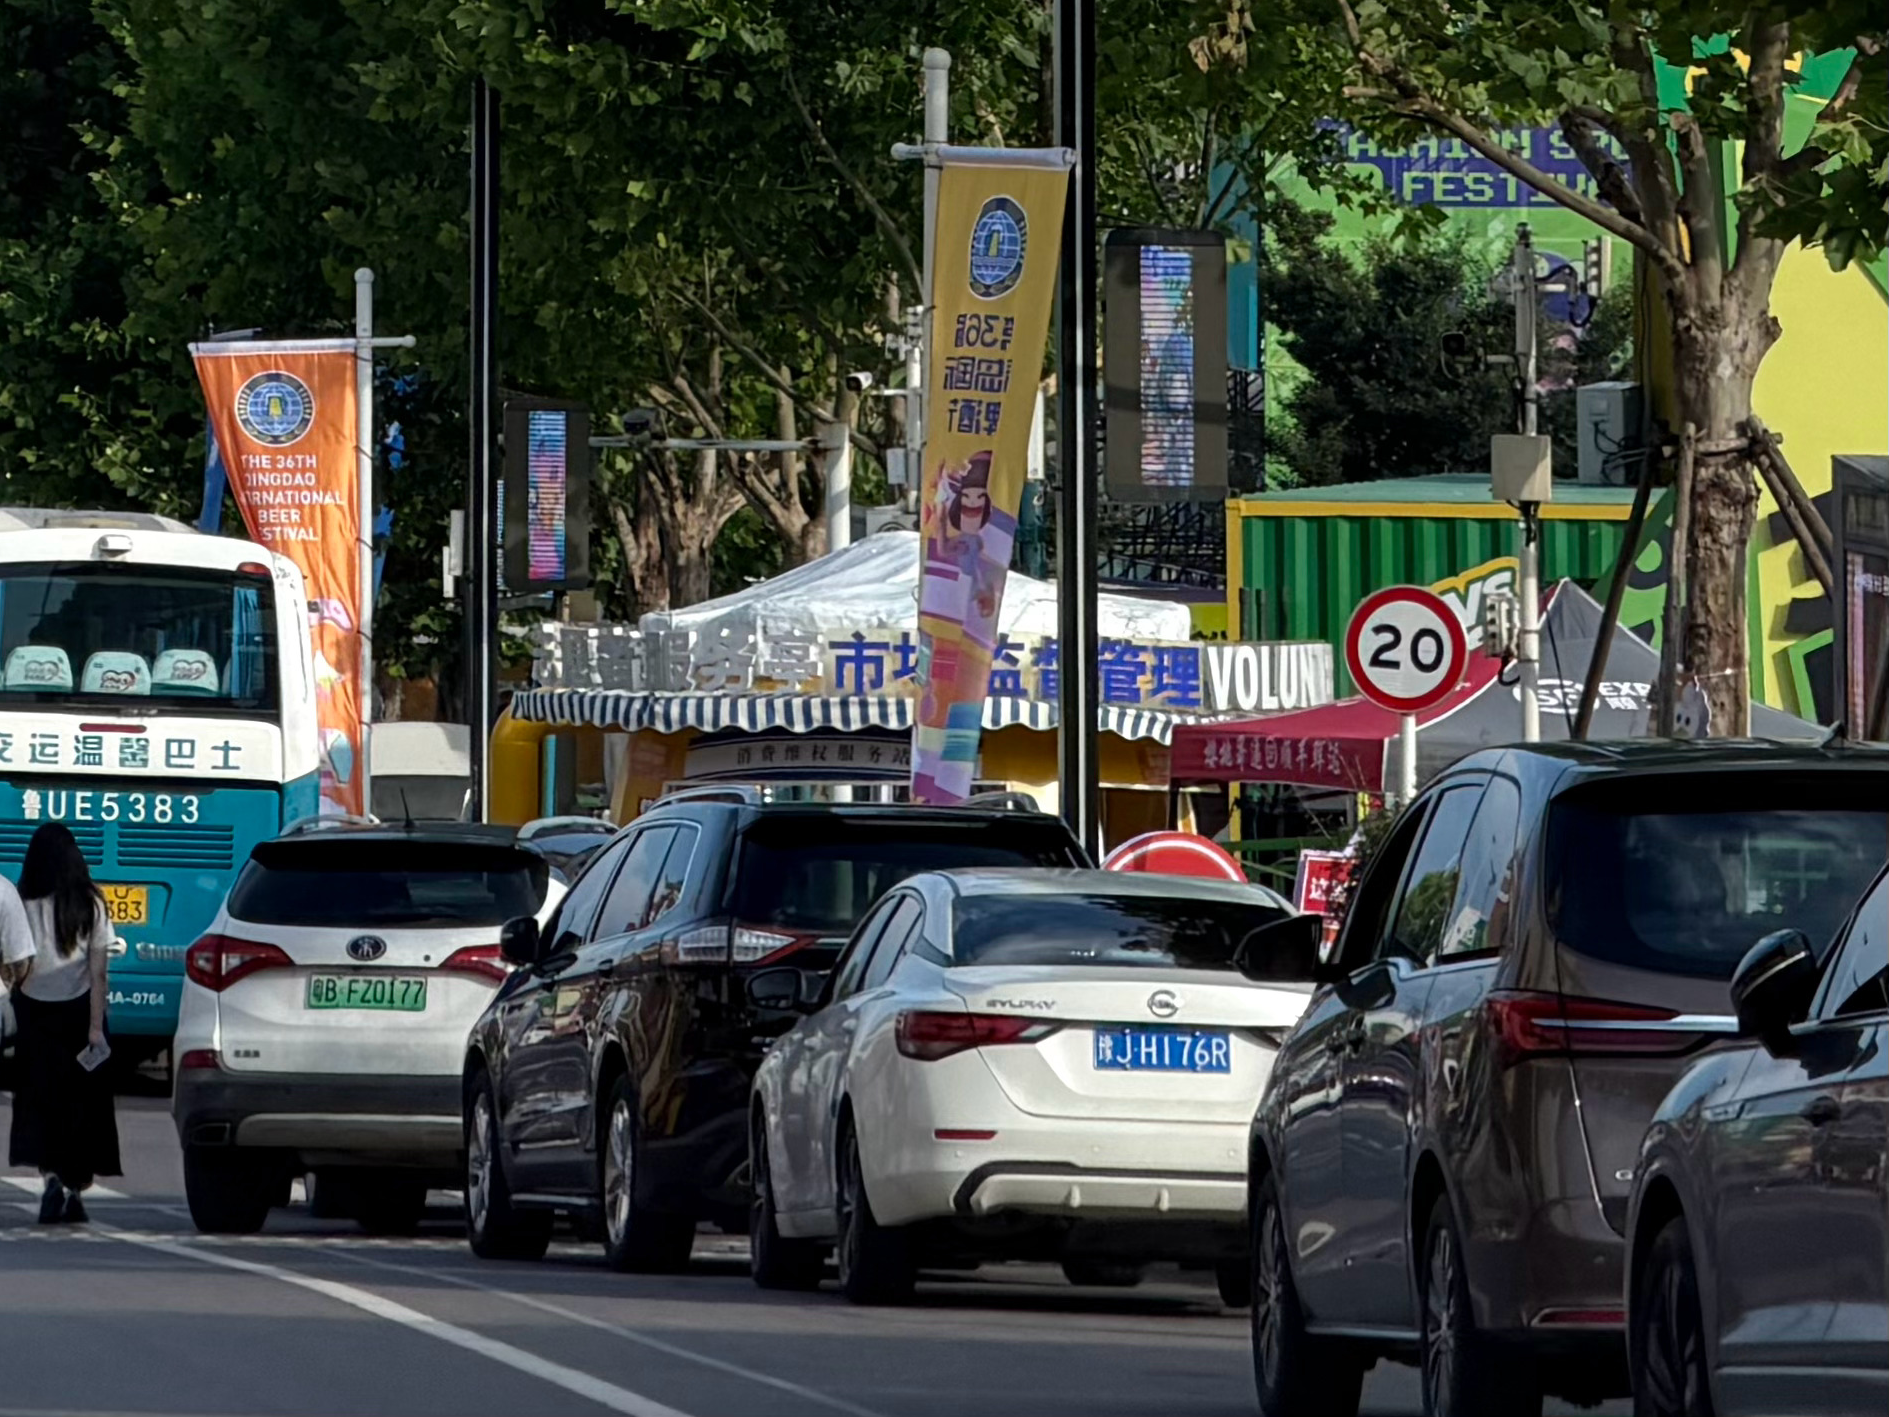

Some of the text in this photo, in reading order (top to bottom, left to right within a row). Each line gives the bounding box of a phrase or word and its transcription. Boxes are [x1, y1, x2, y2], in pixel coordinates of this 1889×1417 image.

[276, 454, 317, 469] 36TH
[258, 508, 301, 524] BEER
[1368, 623, 1445, 674] 20
[22, 788, 199, 824] 鲁UE5383
